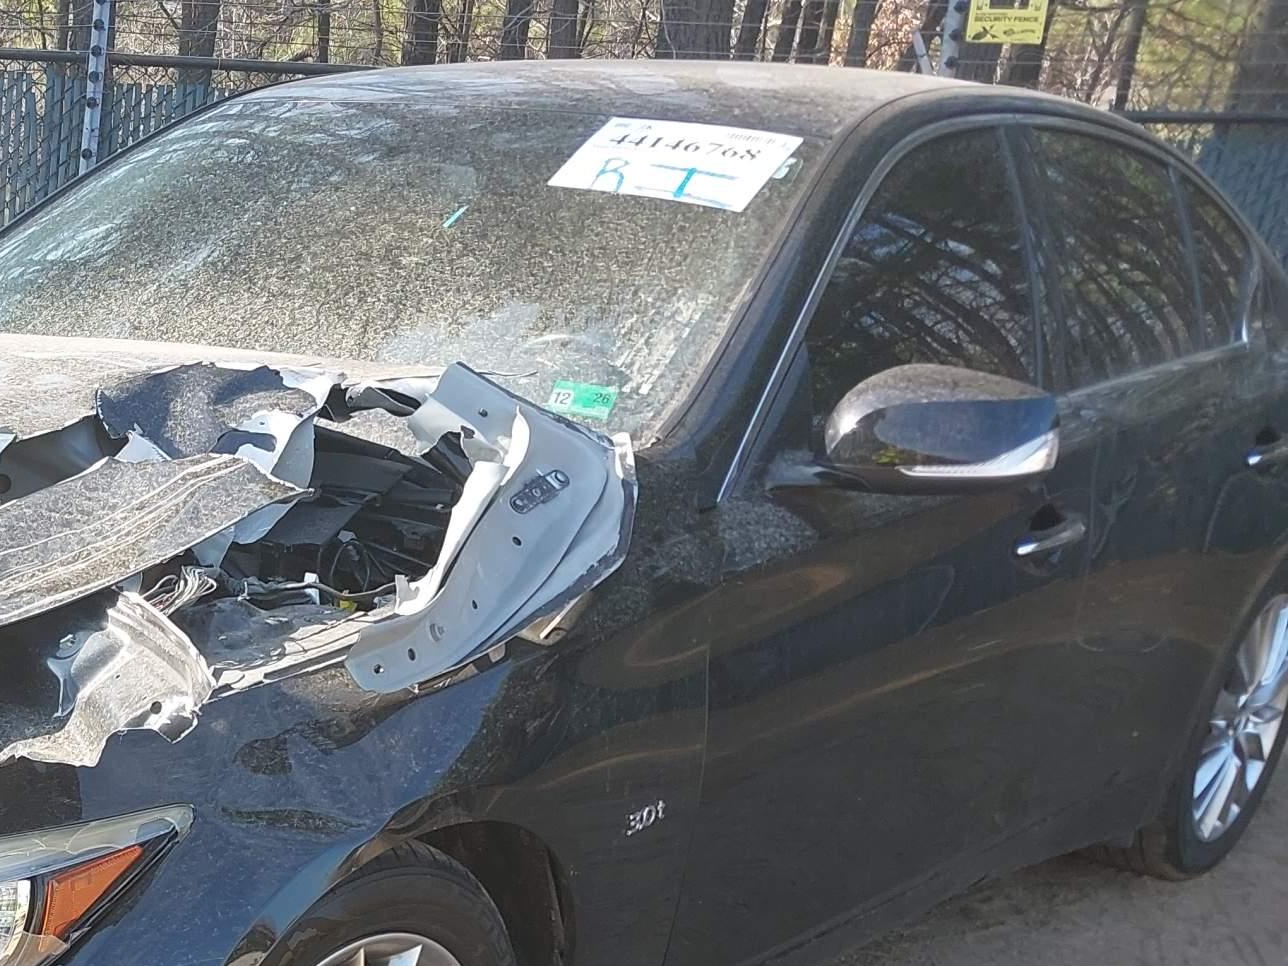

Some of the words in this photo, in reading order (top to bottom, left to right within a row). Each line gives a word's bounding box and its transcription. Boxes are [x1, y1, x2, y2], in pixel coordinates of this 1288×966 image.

[609, 133, 761, 160] 44146768
[553, 391, 572, 405] 12
[592, 392, 611, 405] 26
